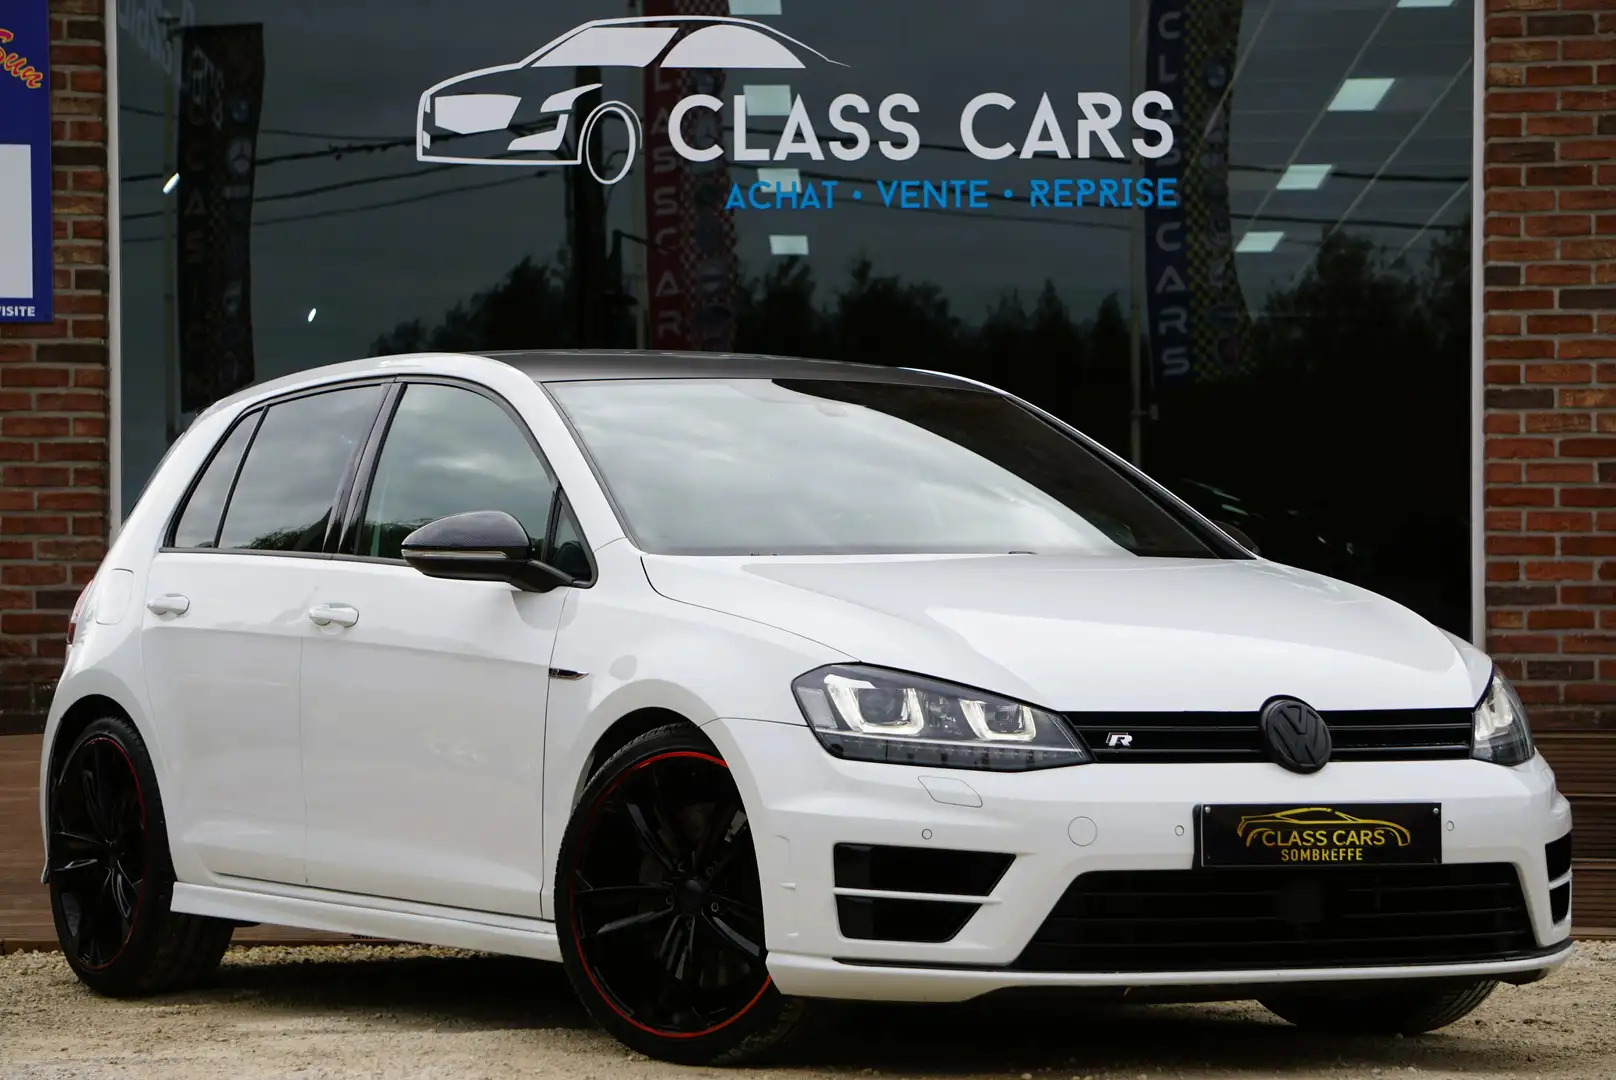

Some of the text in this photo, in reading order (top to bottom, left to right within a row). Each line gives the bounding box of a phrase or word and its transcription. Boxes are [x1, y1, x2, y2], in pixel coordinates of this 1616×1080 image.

[668, 90, 1175, 162] CLASS CARS
[724, 178, 1178, 210] ACHAT VENTE REPRISE
[1106, 731, 1133, 748] R
[1261, 829, 1386, 846] CLASS CARS
[1280, 848, 1363, 862] SOMBREFFE
